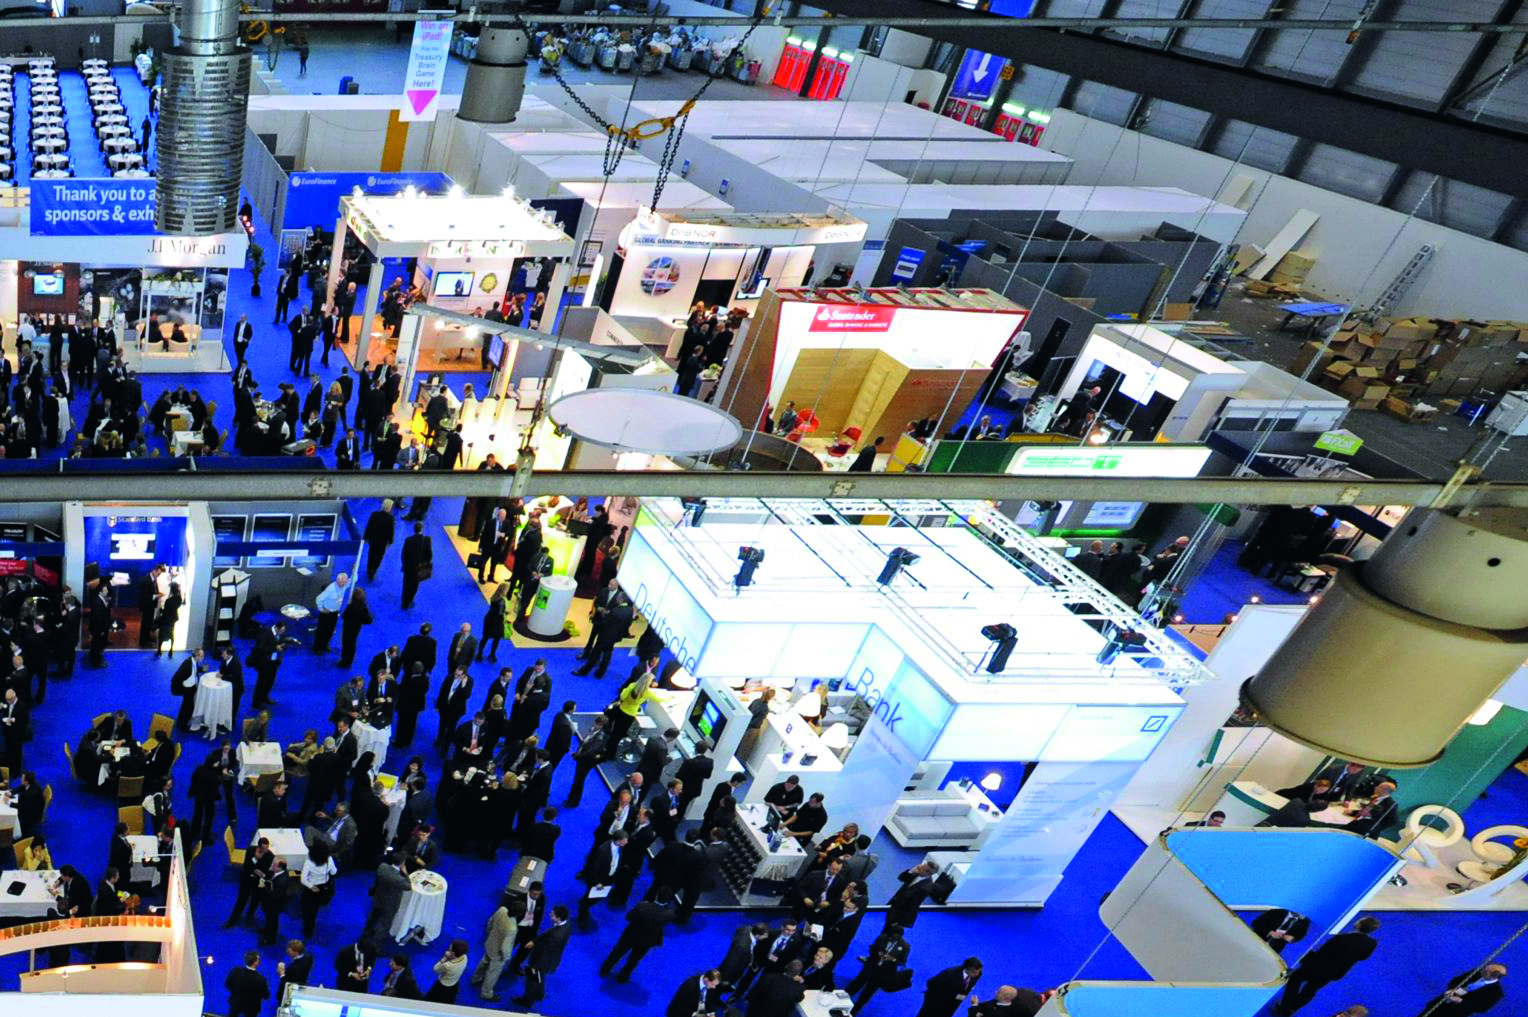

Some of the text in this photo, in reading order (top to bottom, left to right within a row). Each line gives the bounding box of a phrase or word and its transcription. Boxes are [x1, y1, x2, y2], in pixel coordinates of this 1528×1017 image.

[412, 80, 434, 88] Here!
[53, 185, 97, 201] Thank
[100, 188, 126, 206] you
[130, 186, 145, 201] to
[45, 206, 109, 224] sponsors
[112, 205, 125, 224] &
[634, 582, 697, 673] Deutsche
[853, 666, 904, 734] Bank
